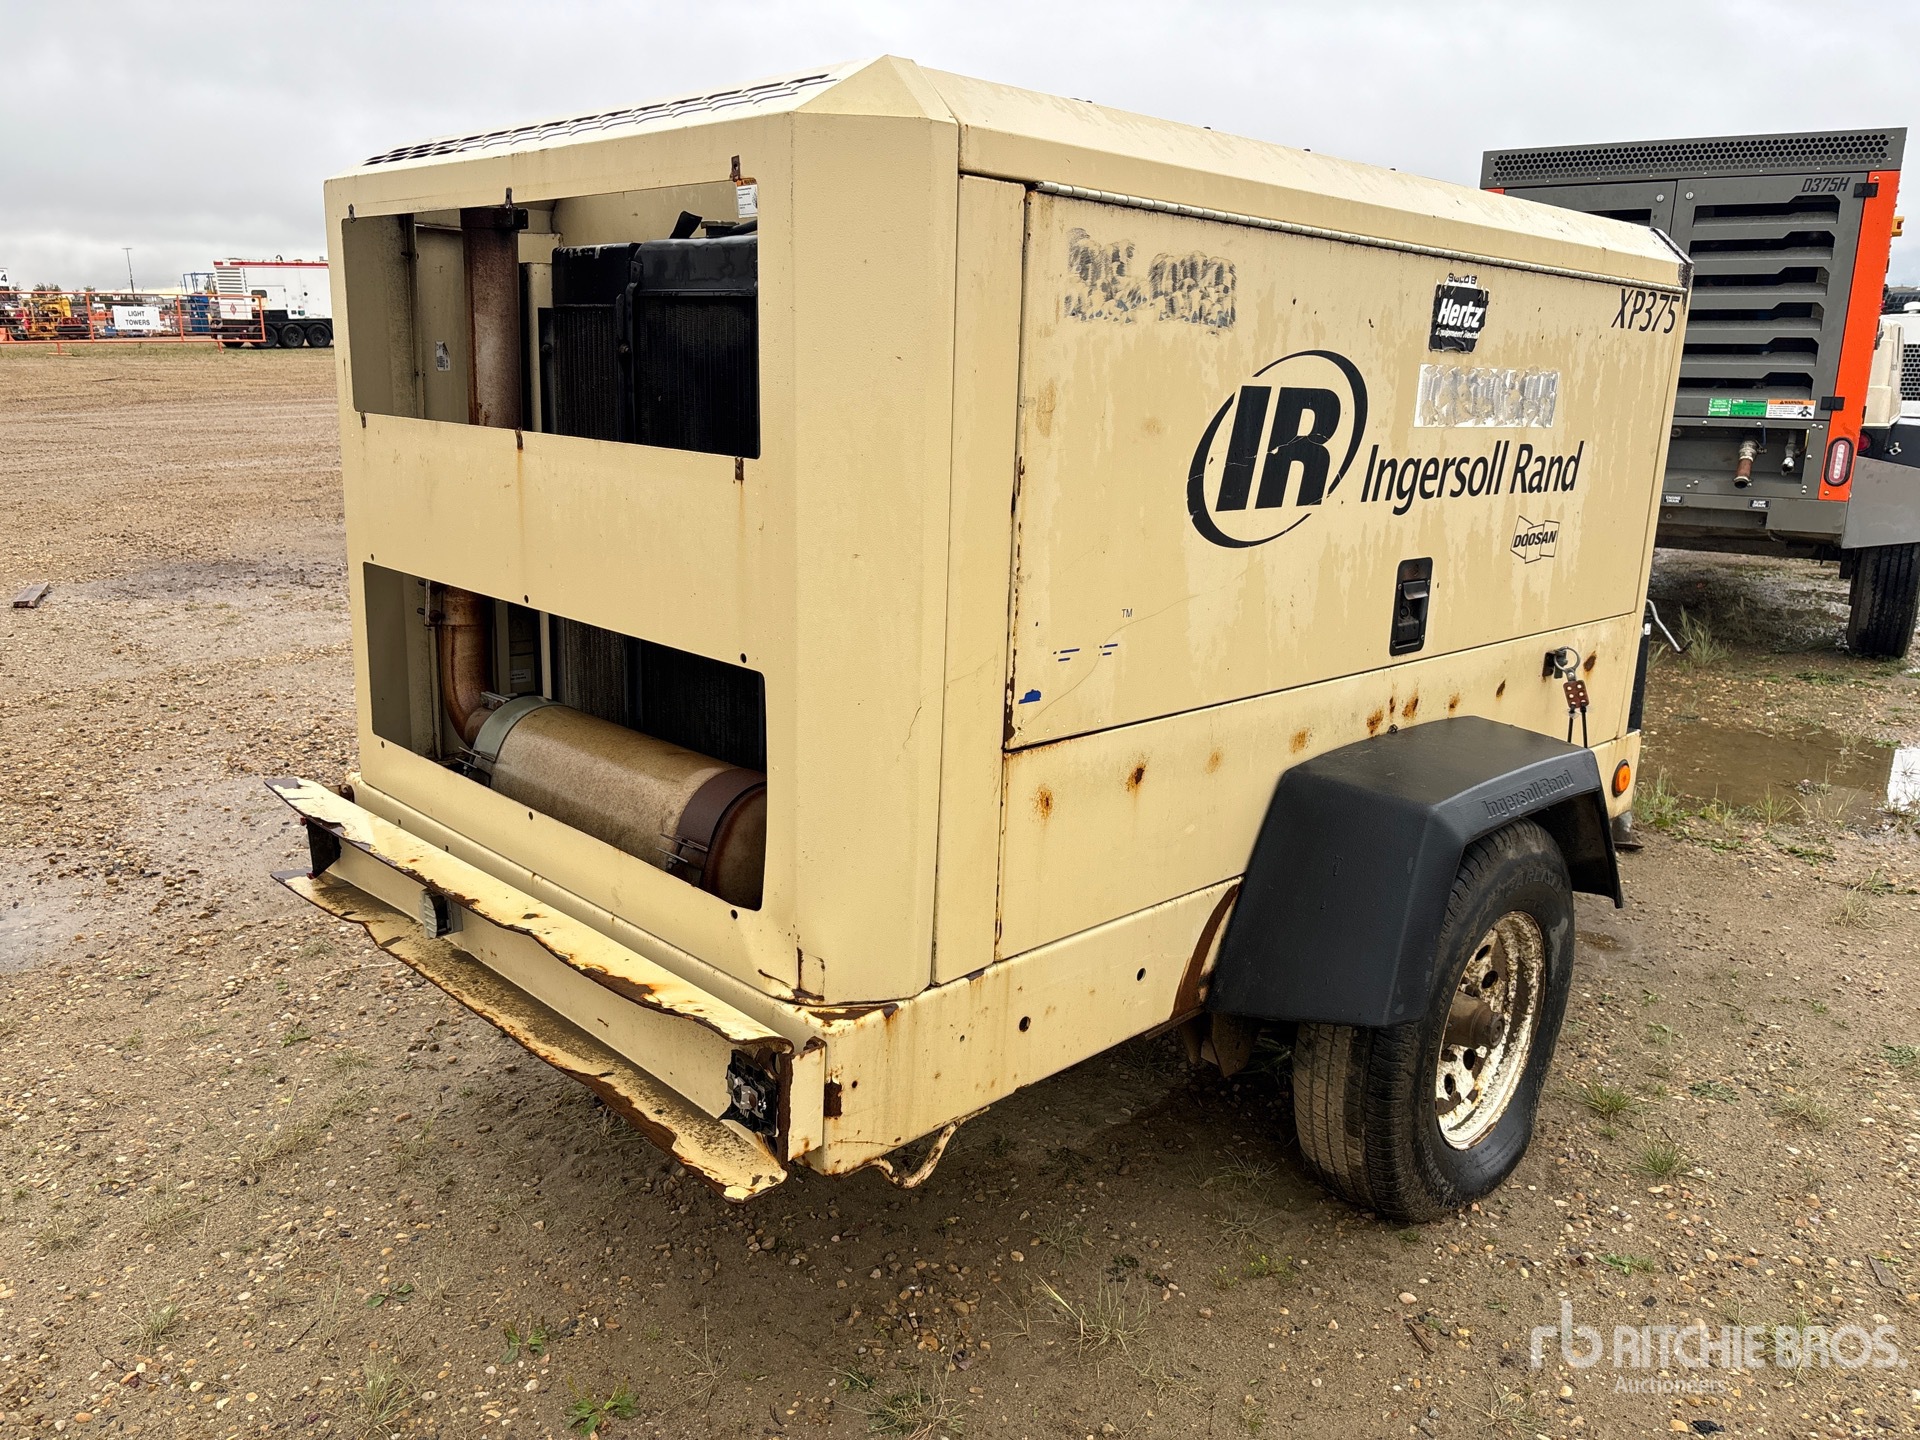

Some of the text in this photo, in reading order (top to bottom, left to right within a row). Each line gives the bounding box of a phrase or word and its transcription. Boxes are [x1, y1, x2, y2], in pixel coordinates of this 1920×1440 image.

[1801, 177, 1850, 192] D375H
[1437, 298, 1485, 328] Hertz
[1611, 288, 1680, 334] XP375
[1215, 386, 1341, 512] IR
[1361, 440, 1585, 516] Ingersoll Rand
[1513, 530, 1557, 548] DOOSAN
[1122, 608, 1133, 618] TM
